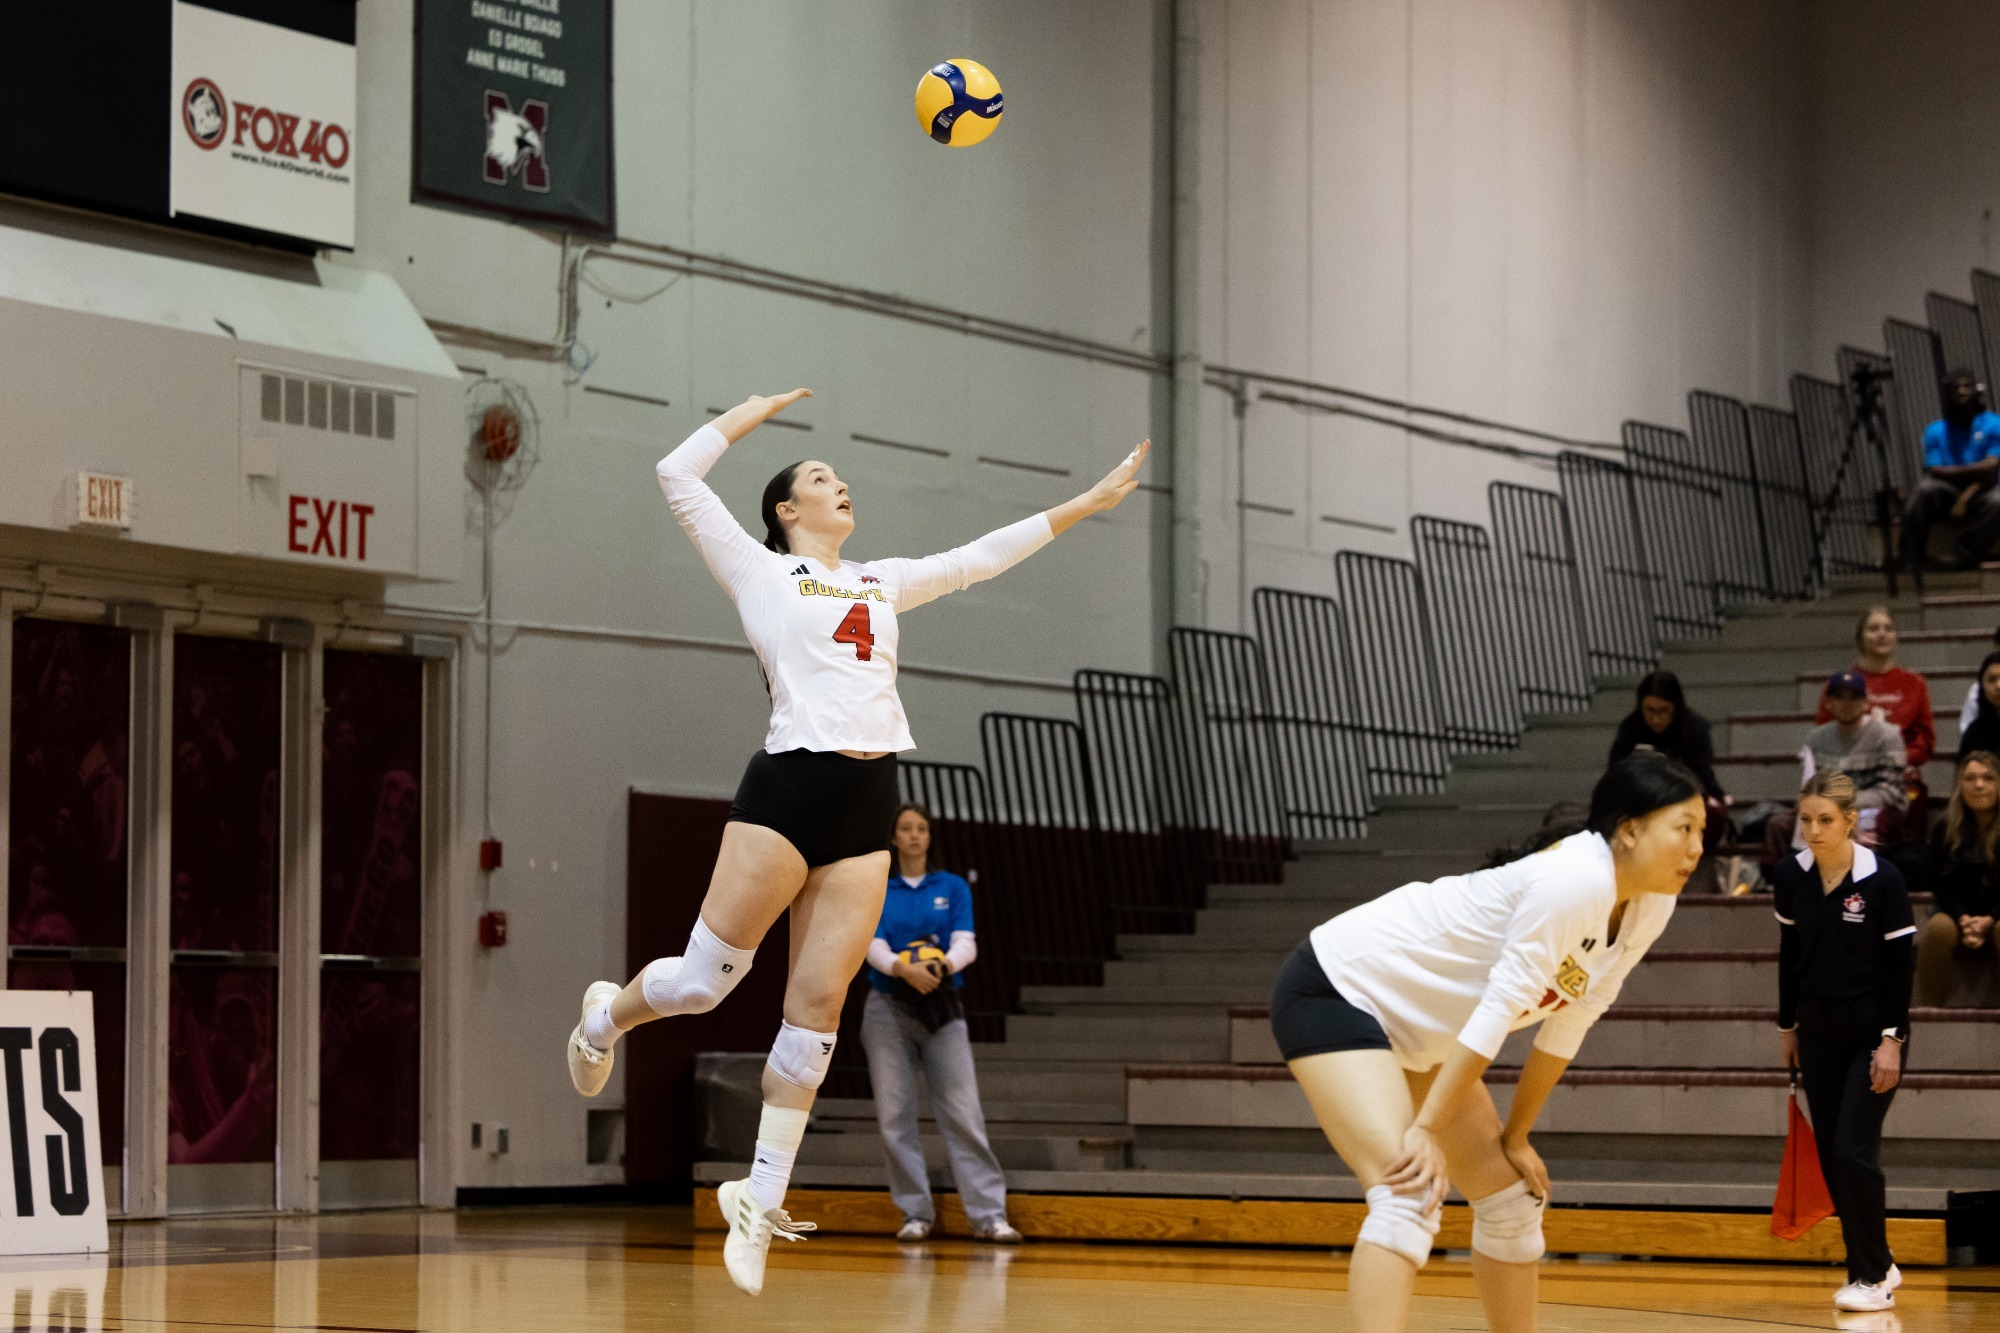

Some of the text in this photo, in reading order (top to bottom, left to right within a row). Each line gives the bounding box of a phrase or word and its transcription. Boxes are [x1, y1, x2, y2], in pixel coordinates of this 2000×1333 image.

[87, 476, 123, 521] EXIT
[288, 494, 375, 561] EXIT
[832, 603, 875, 661] 4
